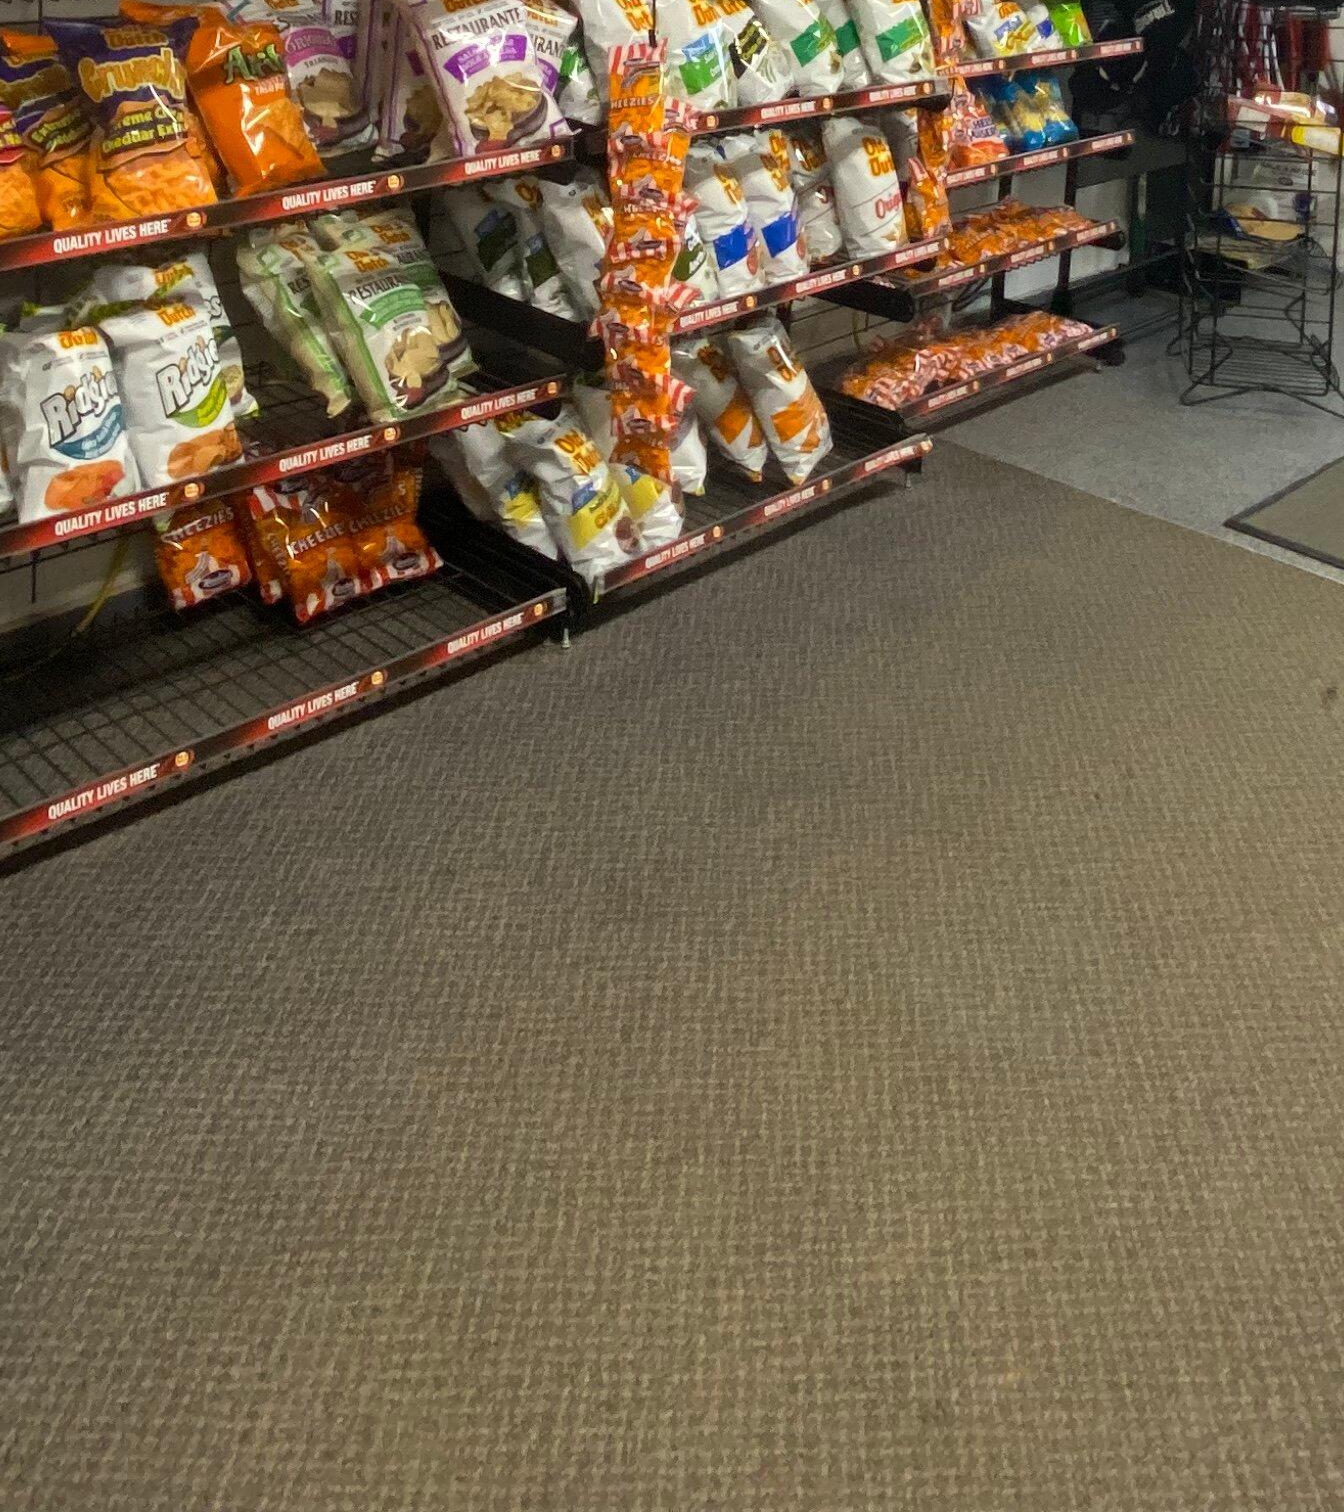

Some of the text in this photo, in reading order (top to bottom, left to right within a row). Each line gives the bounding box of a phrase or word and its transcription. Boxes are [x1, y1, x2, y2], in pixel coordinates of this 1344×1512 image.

[465, 157, 497, 175] QUALITY
[498, 153, 521, 168] LIVES
[282, 182, 375, 211] QUALITY LIVES HERE
[53, 219, 170, 254] QUALITY LIVES HERE
[461, 400, 494, 420] QUALITY
[495, 395, 516, 411] LIVES
[279, 436, 371, 470] QUALITY LIVES HERE
[54, 494, 169, 536] QUALITY LIVES HERE
[447, 612, 524, 655] QUALITY LIVES HERE
[267, 681, 360, 730] QUALITY LIVES HERE
[48, 763, 160, 822] QUALITY LIVES HERE
